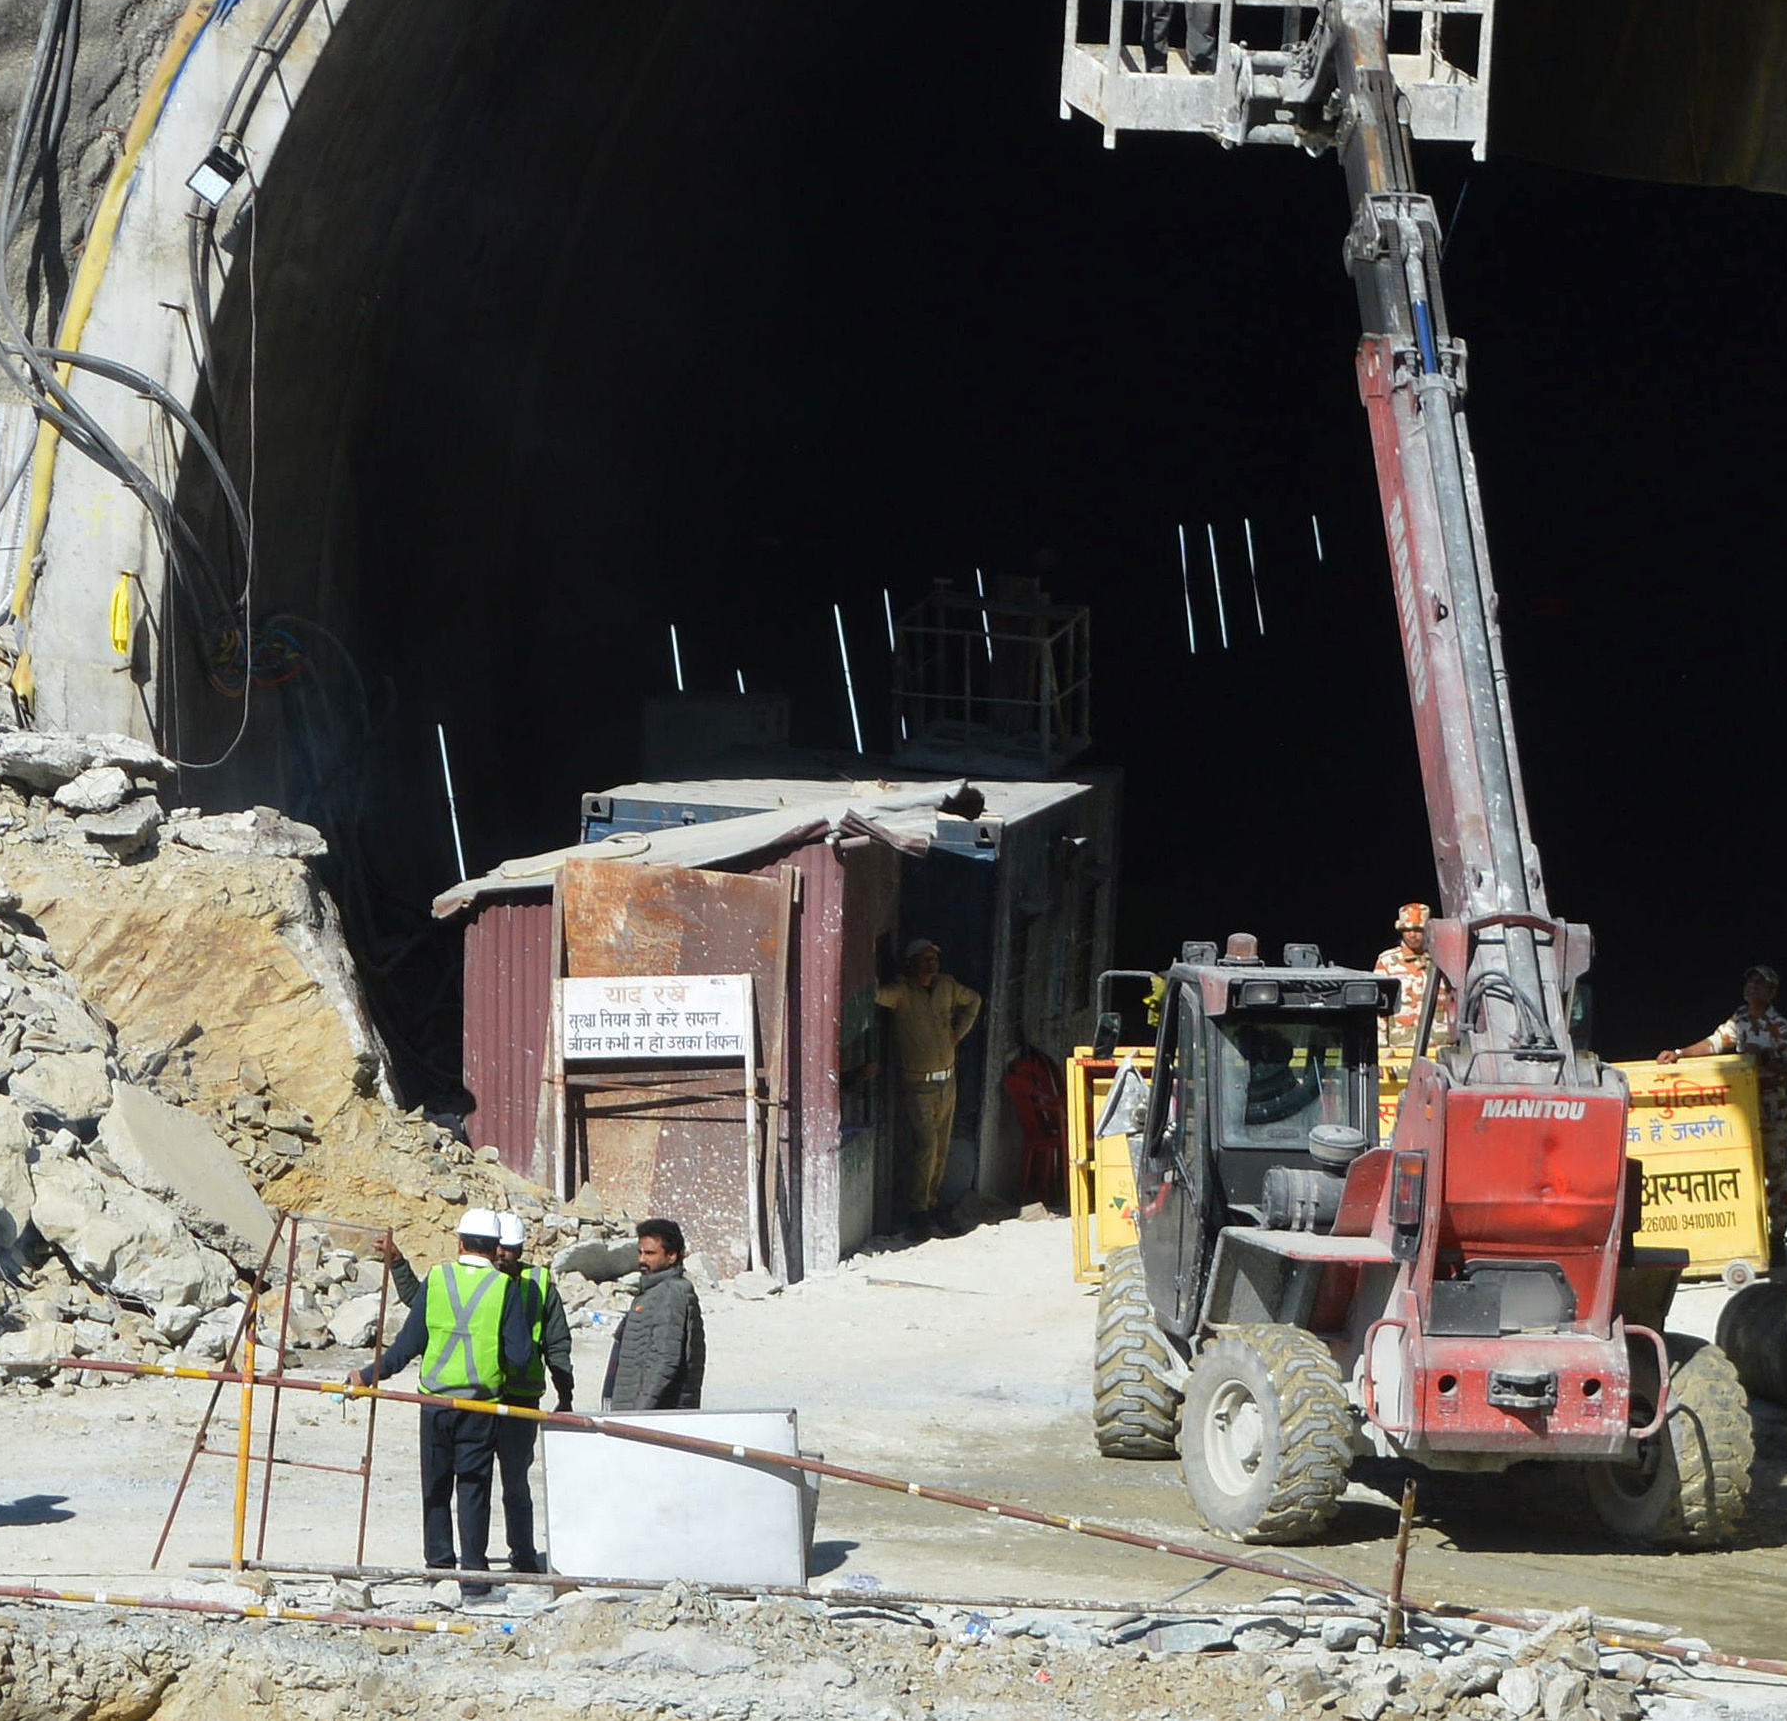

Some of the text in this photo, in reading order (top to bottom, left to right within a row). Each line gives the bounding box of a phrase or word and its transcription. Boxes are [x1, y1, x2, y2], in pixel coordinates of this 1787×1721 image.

[1389, 495, 1428, 706] MANITOU
[599, 1008, 630, 1027] नियम
[633, 1008, 653, 1027] जो
[684, 1012, 721, 1027] सफल
[567, 1031, 602, 1052] जीवन
[605, 1032, 631, 1051] कभी
[633, 1036, 644, 1050] न
[648, 1033, 665, 1053] हो
[666, 1035, 702, 1051] उसका
[1481, 1098, 1587, 1121] MANITOU
[1648, 1079, 1732, 1120] पुलिस
[1641, 1168, 1741, 1207] अस्पताल
